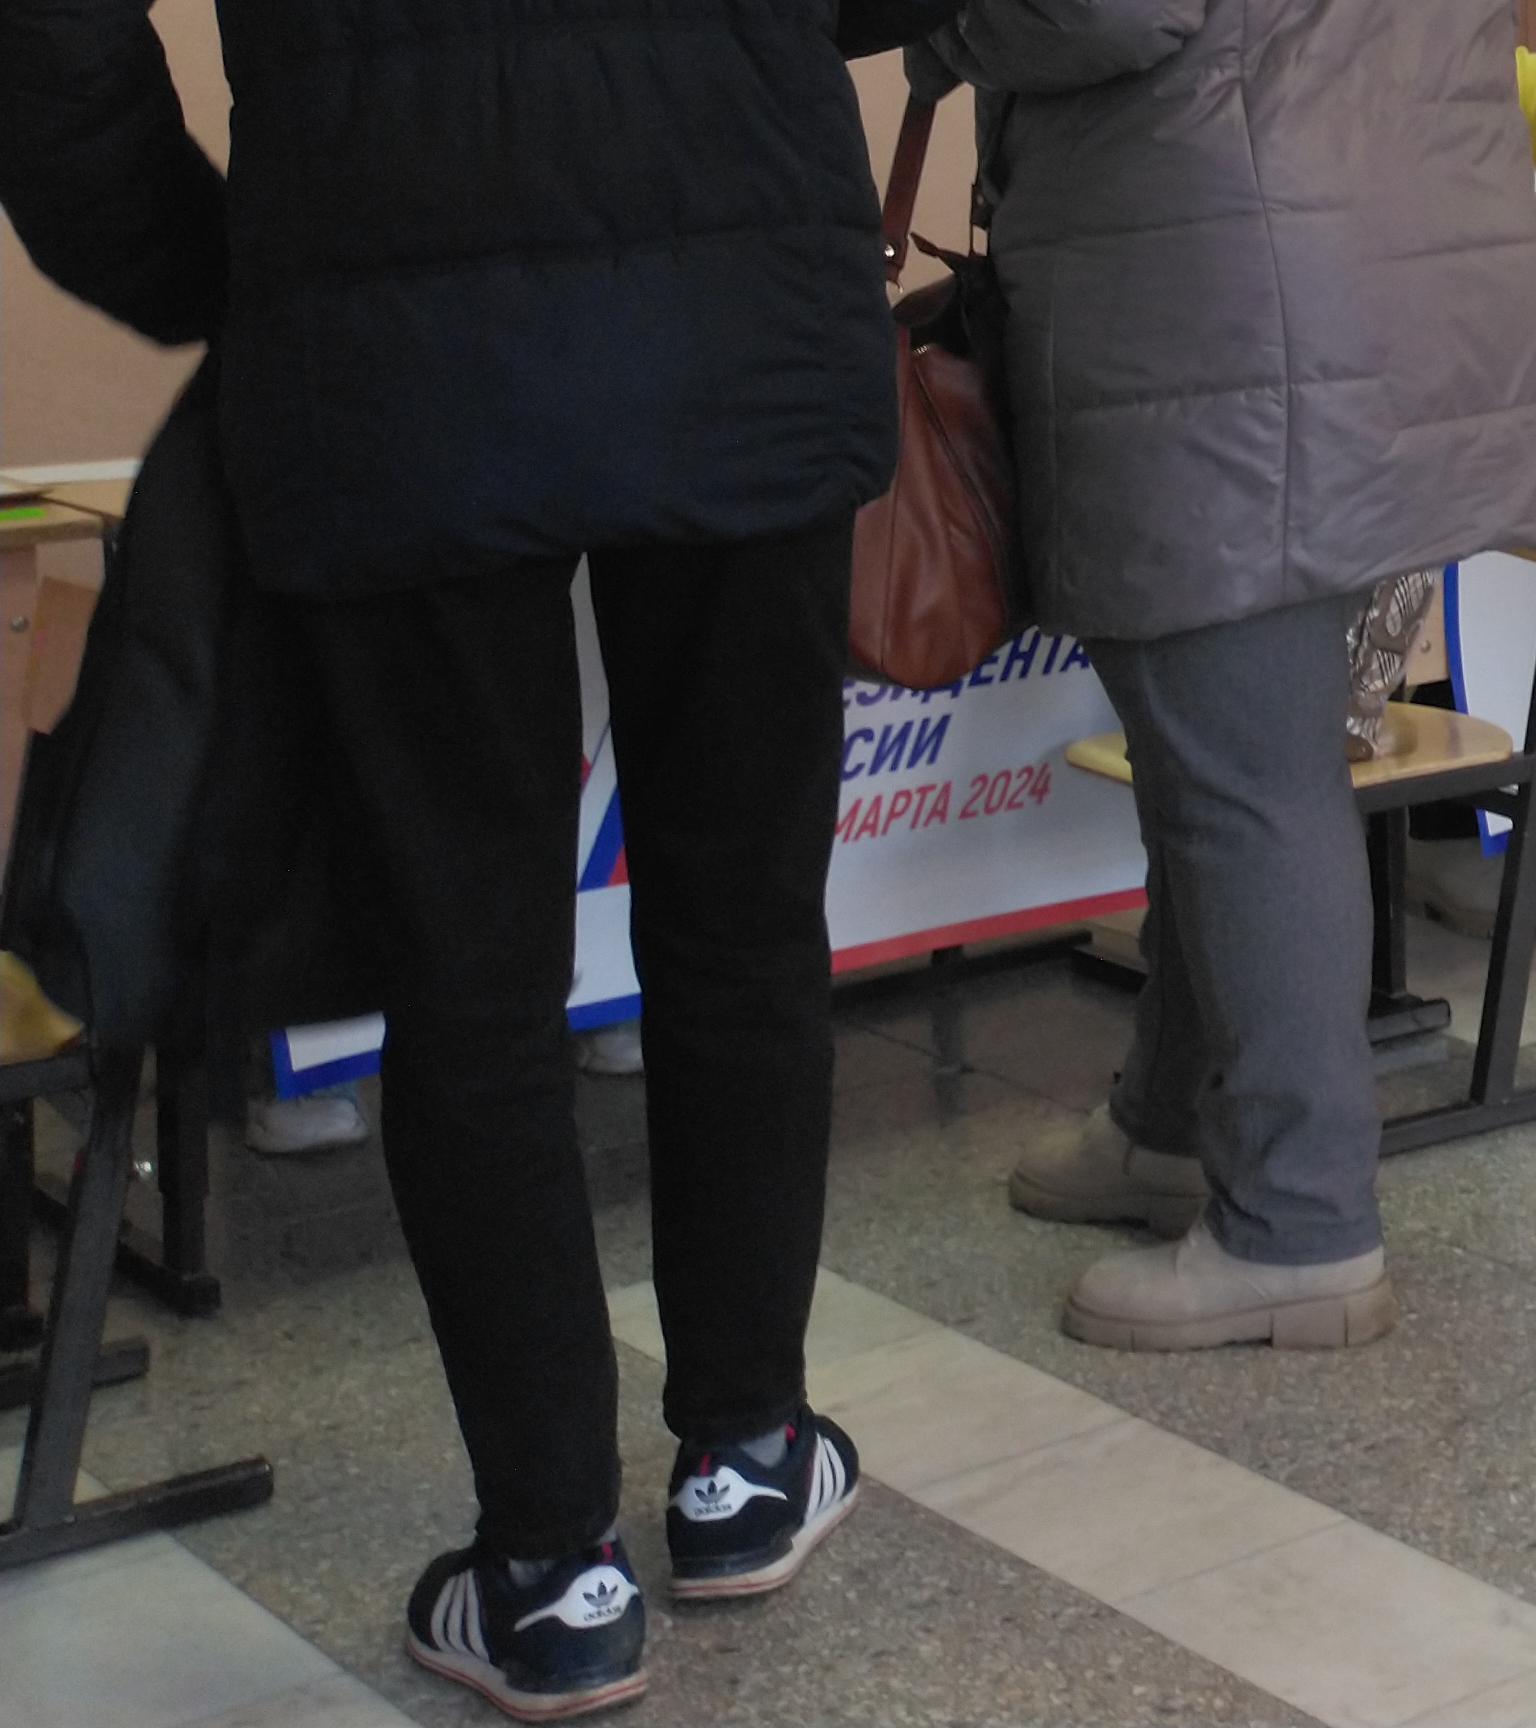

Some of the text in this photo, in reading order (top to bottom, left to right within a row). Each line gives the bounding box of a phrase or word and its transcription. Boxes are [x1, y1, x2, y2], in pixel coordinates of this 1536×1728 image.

[840, 713, 952, 782] СИИ
[834, 761, 1053, 843] МАРТА 2024
